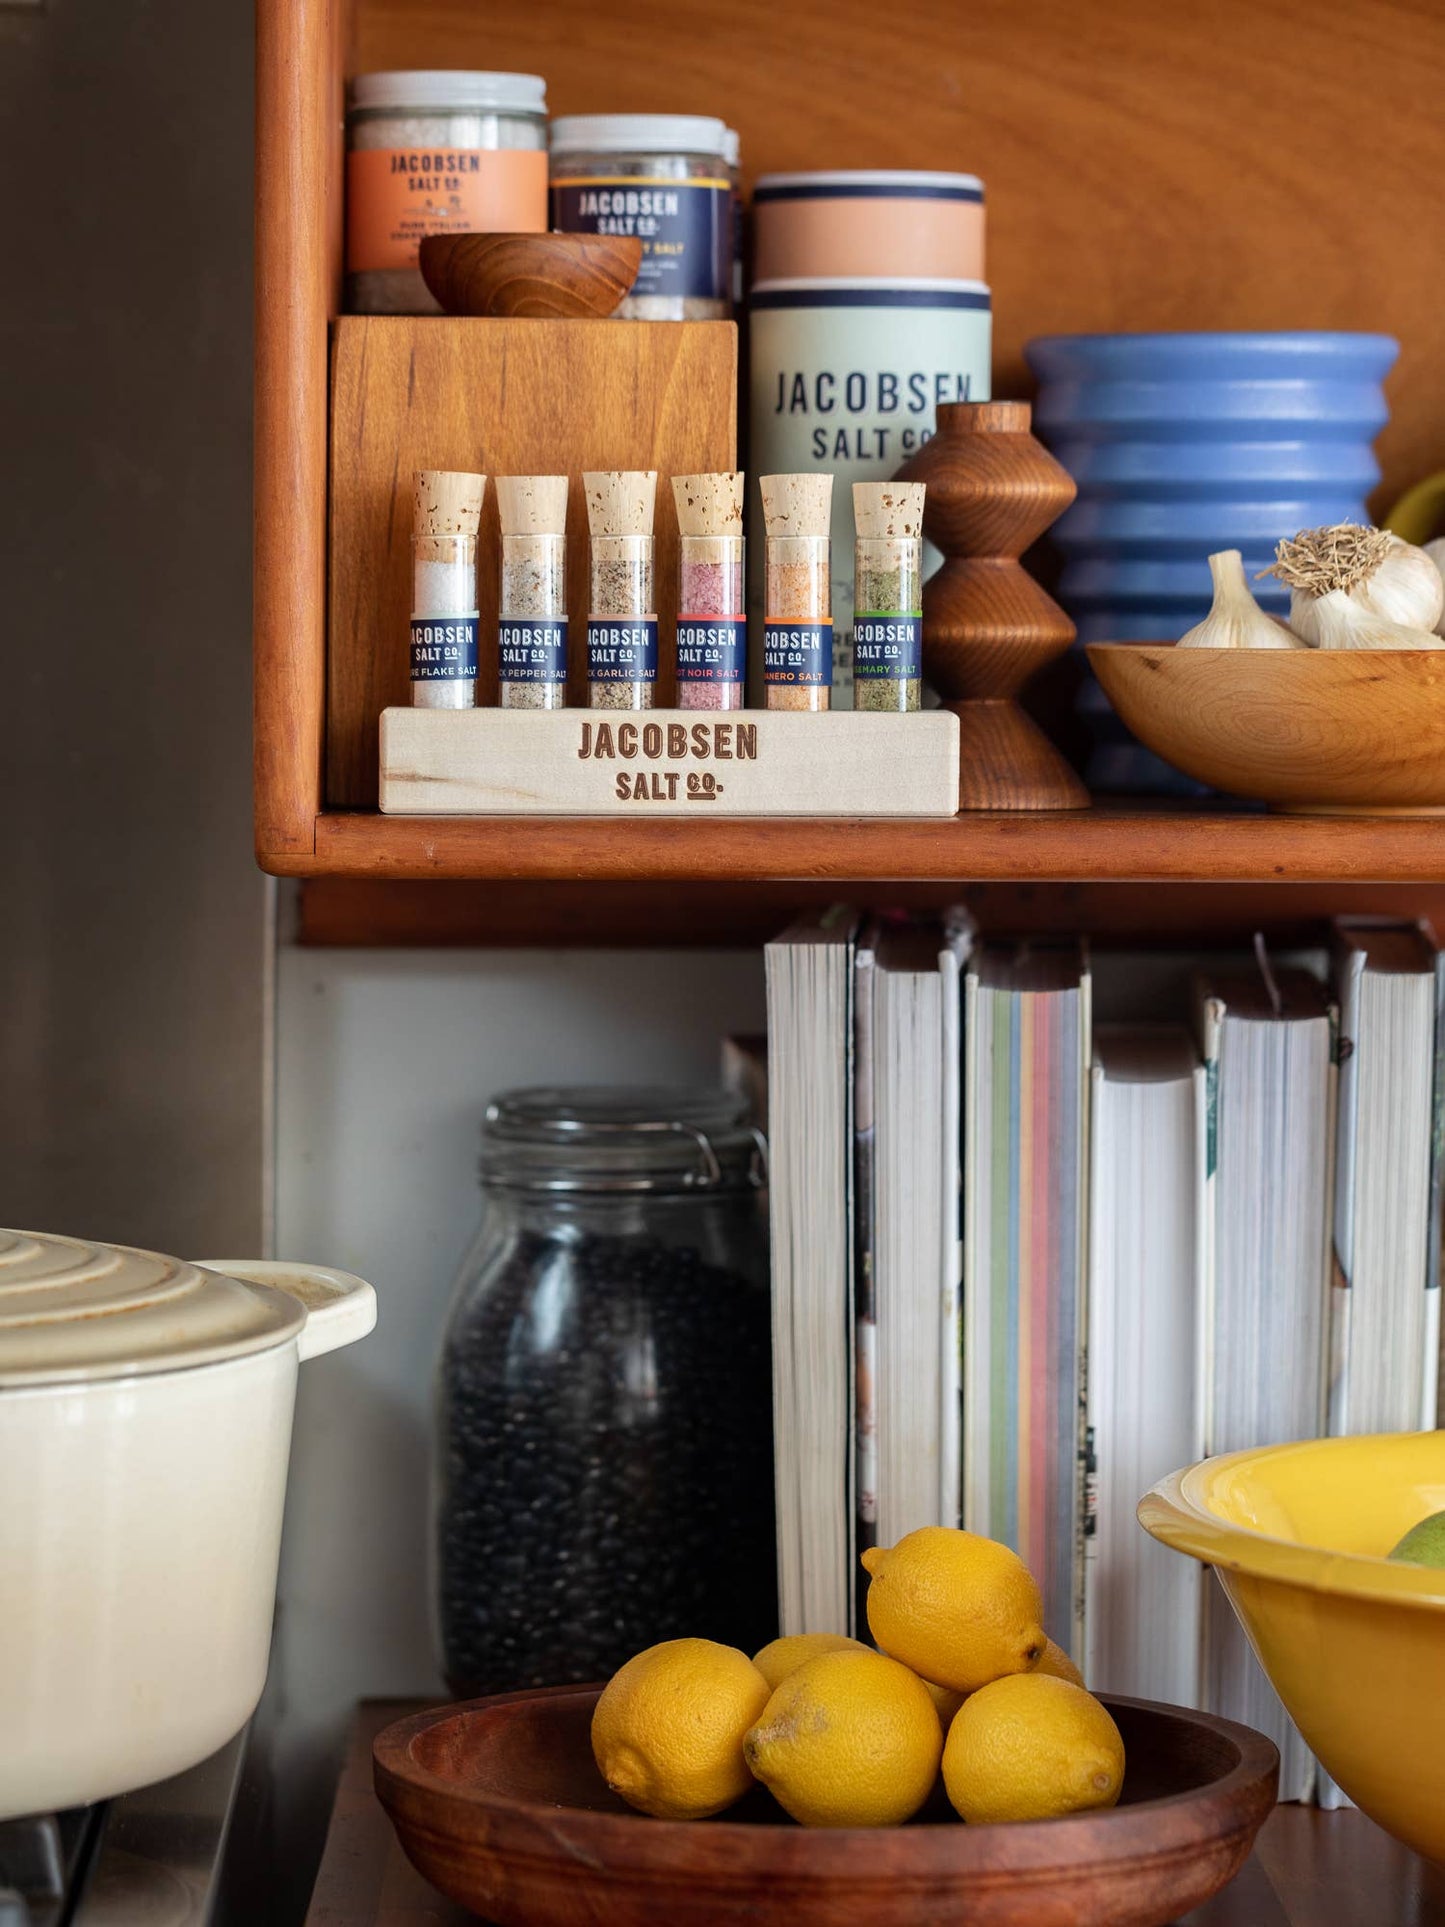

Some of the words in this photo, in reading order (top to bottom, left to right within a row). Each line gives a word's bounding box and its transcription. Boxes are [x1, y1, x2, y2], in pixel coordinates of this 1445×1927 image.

[391, 155, 480, 173] JACOBSEN
[408, 177, 440, 192] SALT
[579, 192, 679, 216] JACOBSEN
[597, 216, 634, 236] SALT
[776, 372, 971, 414] JACOBSEN
[813, 428, 890, 460] SALT
[415, 648, 442, 661] SALT
[445, 648, 461, 660] CO.
[503, 649, 528, 662] SALT
[531, 650, 549, 662] CO.
[591, 649, 617, 662] SALT
[619, 650, 637, 662] CO.
[679, 649, 702, 662] SALT
[705, 650, 723, 662] CO.
[857, 645, 881, 658] SALT
[884, 646, 901, 658] CO.
[765, 652, 785, 665] SALT
[788, 653, 805, 666] CO.
[421, 667, 455, 676] FLAKE
[458, 666, 477, 675] SALT
[508, 669, 547, 678] PEPPER
[550, 670, 567, 678] SALT
[597, 669, 635, 678] GARLIC
[638, 669, 655, 678] SALT
[688, 669, 713, 678] NOIR
[716, 669, 739, 678] SALT
[894, 665, 916, 674] SALT
[798, 672, 823, 681] SALT
[578, 723, 757, 759] JACOBSEN
[616, 772, 680, 800] SALT
[687, 773, 724, 800] CO.
